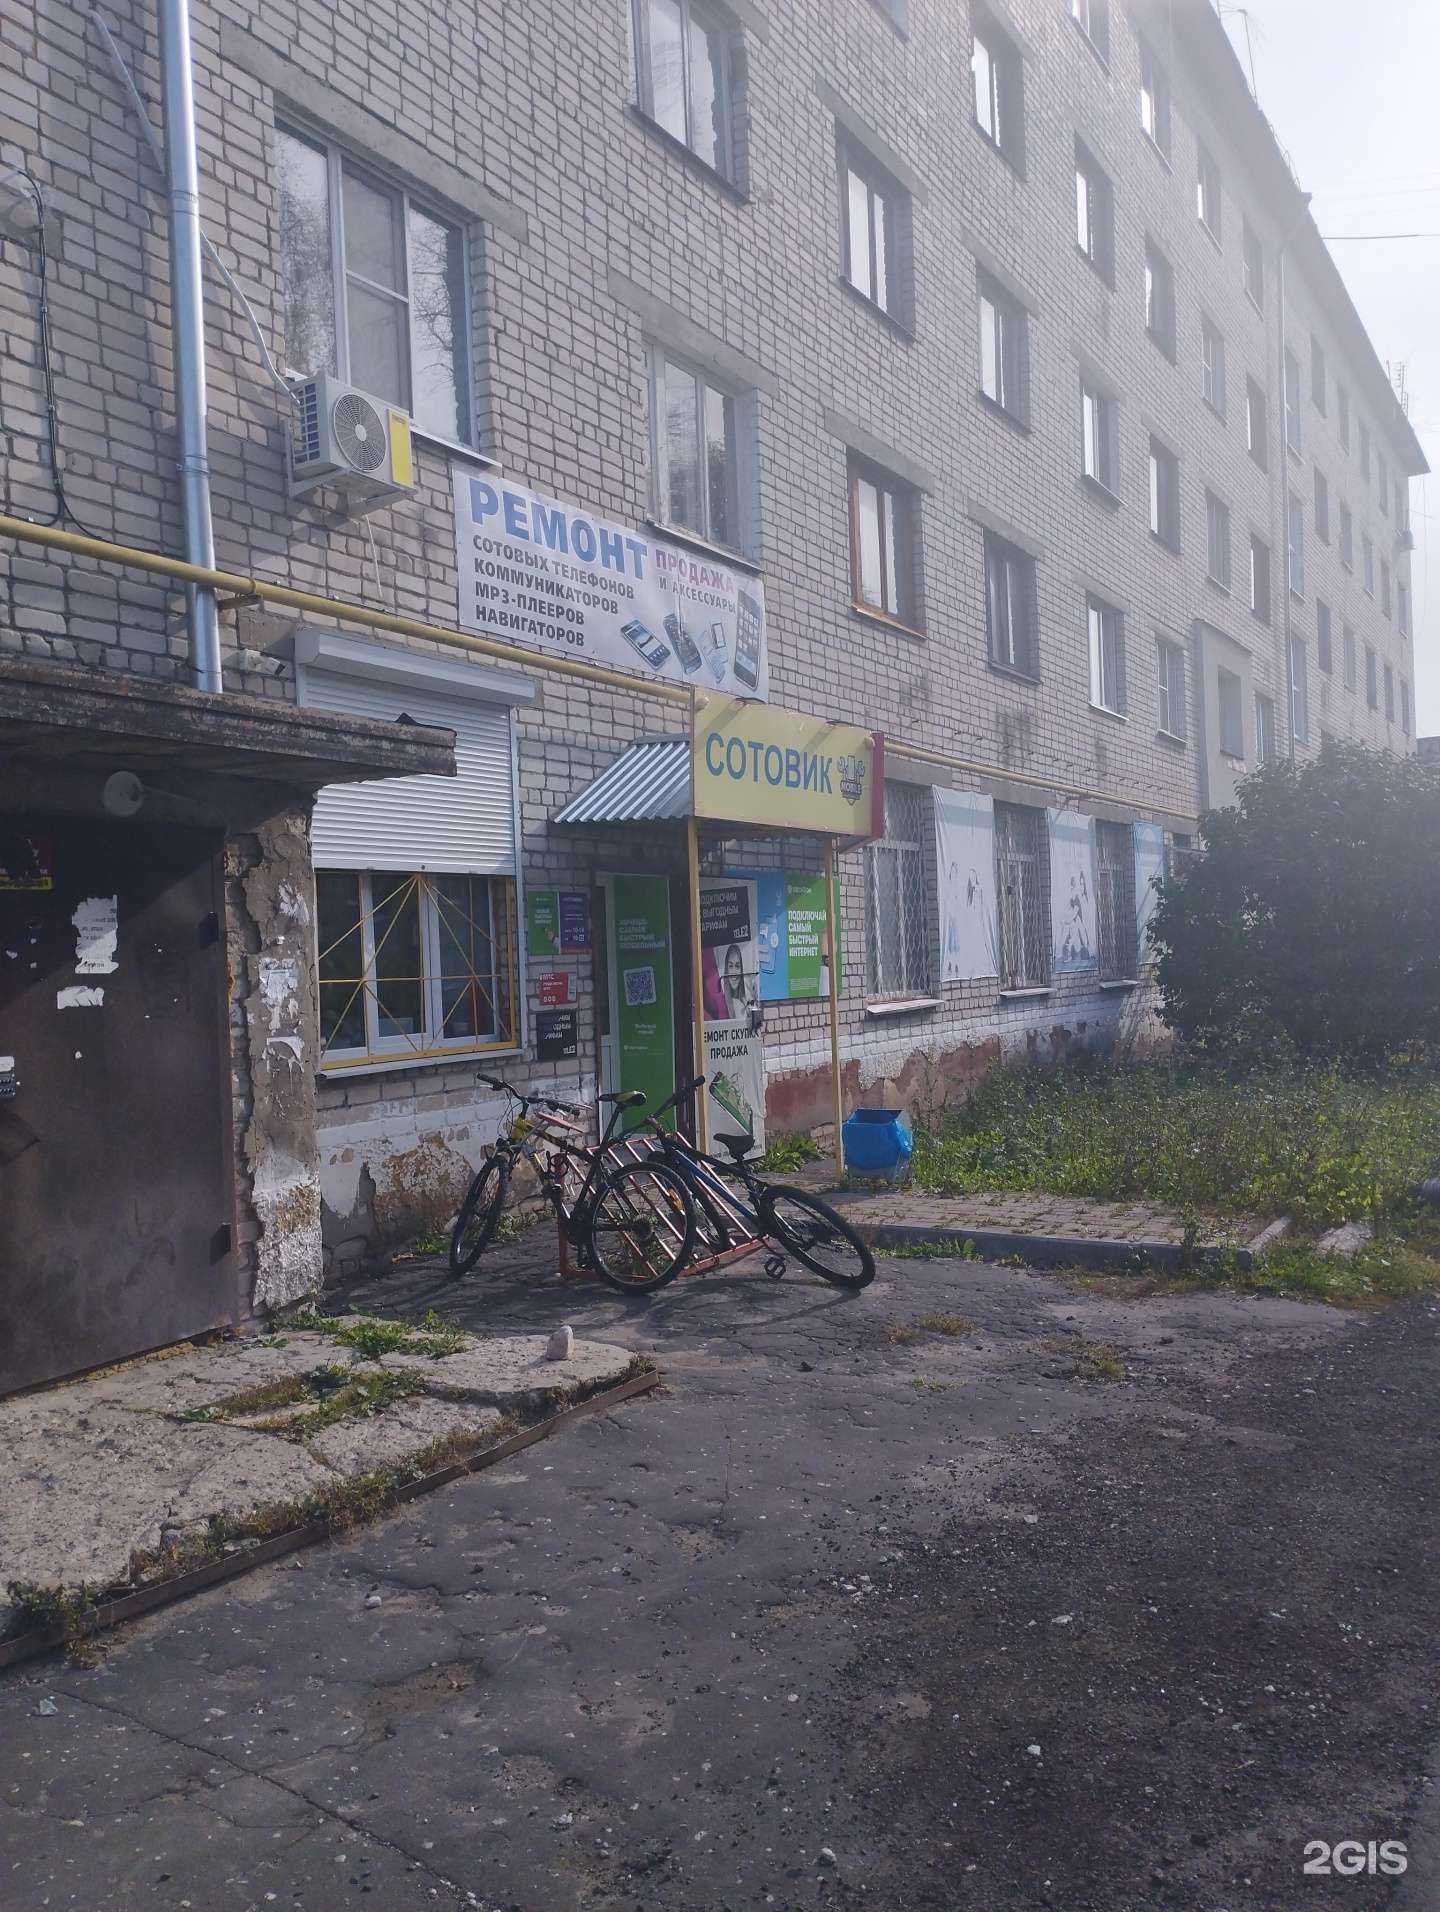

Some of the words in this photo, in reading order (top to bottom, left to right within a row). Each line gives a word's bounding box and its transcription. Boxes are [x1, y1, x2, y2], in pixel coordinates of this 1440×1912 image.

[468, 478, 648, 580] РЕМОНТ
[472, 534, 550, 572] СОТОВЫХ
[551, 559, 635, 599] ТЕЛЕФОНОВ
[474, 558, 618, 615] КОММУНИКАТОРОВ
[655, 549, 736, 593] ПРОДАЖА
[659, 576, 667, 590] И
[673, 581, 736, 614] АКСЕССУАРЫ
[475, 604, 585, 647] НАВИГАТОРОВ
[705, 732, 833, 795] СОТОВИК
[788, 909, 827, 921] ПОДКЛЮЧАЙ
[788, 921, 812, 932] САМЫЙ
[788, 933, 819, 945] БЫСТРЫЙ
[789, 946, 818, 957] ИНТЕРНЕТ
[710, 1045, 749, 1060] ПРОДАЖА
